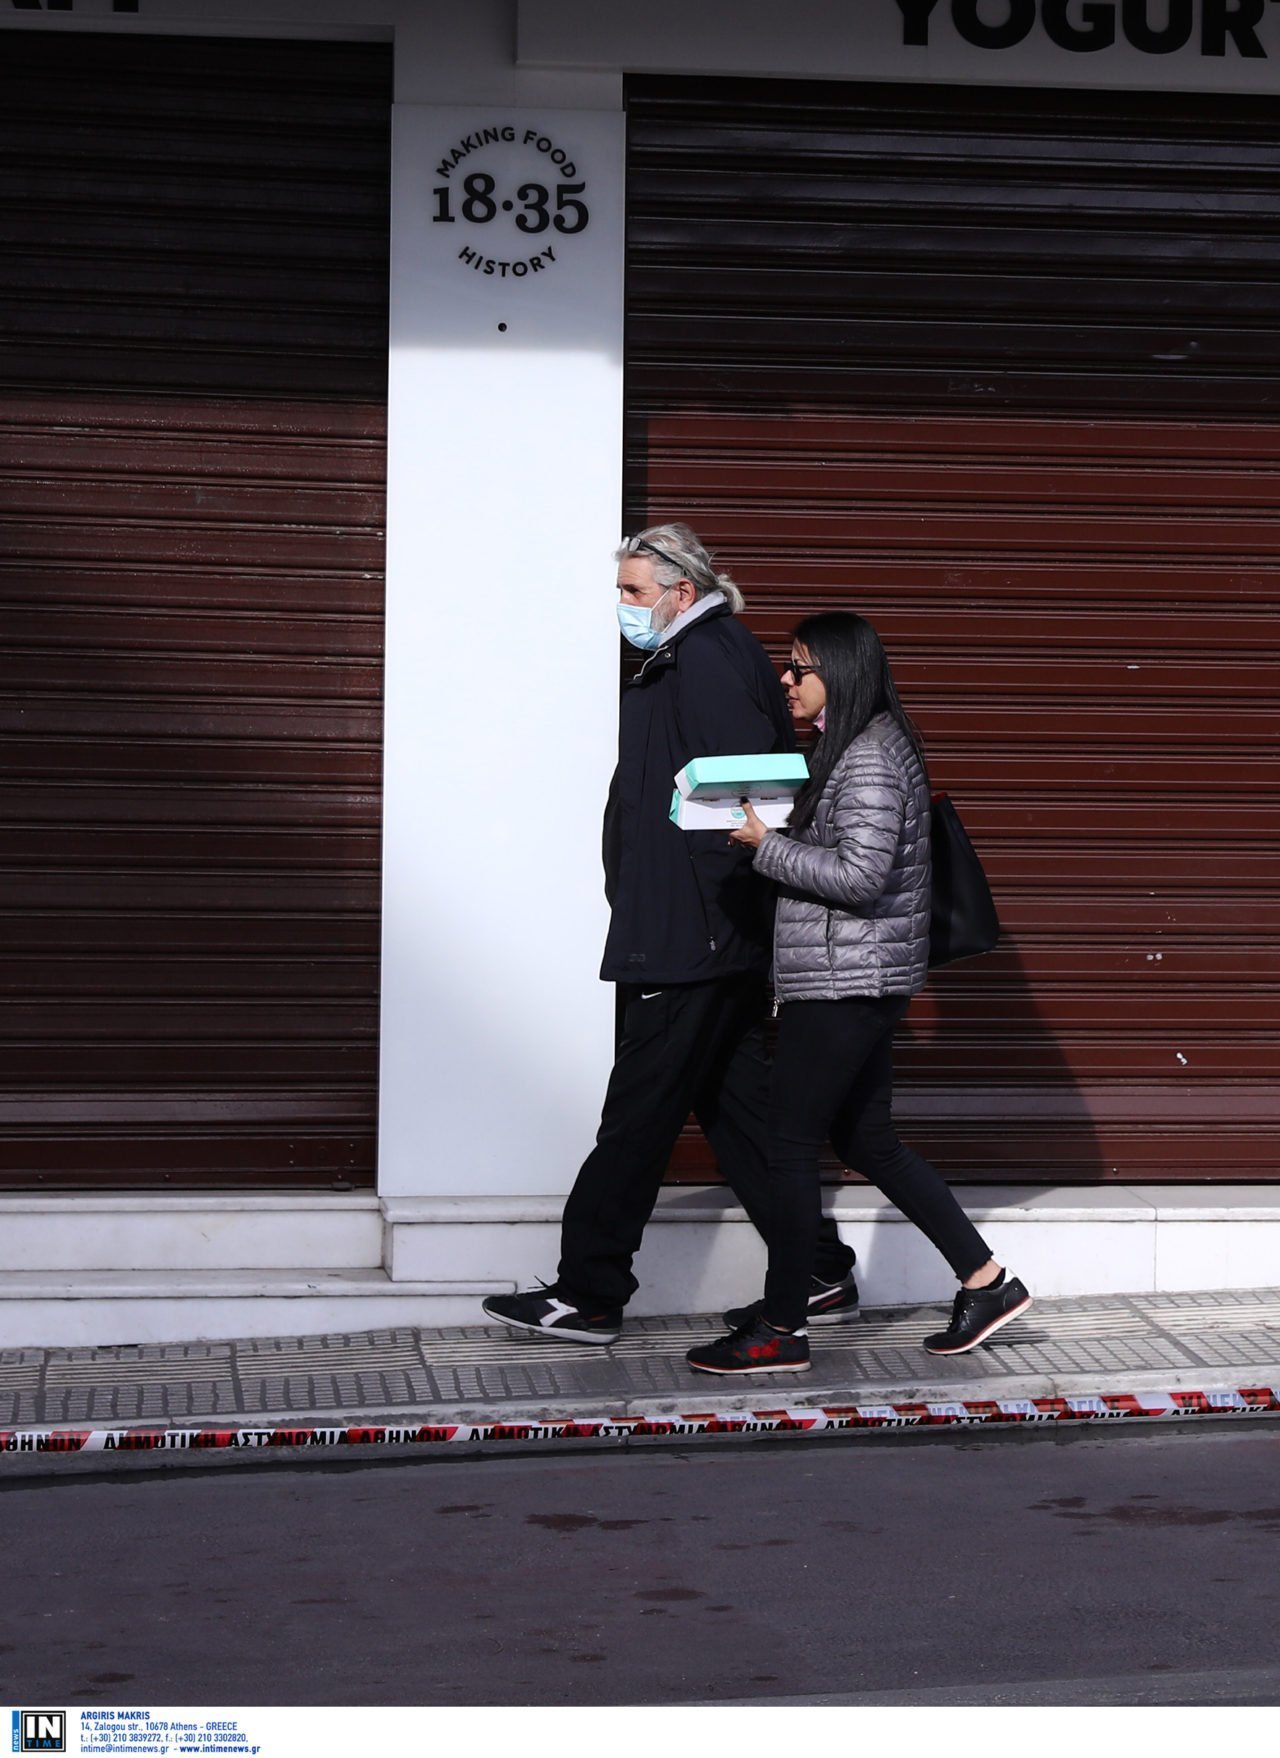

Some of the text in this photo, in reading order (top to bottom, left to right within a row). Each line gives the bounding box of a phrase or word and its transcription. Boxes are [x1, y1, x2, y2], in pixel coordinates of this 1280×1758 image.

[436, 127, 576, 178] MAKING FOOD
[459, 246, 556, 277] HISTORY
[104, 1432, 216, 1450] ΔΗΜΟΤΙΚΗ
[230, 1431, 347, 1448] ΑΣΤΥΝΟΜΙΑ
